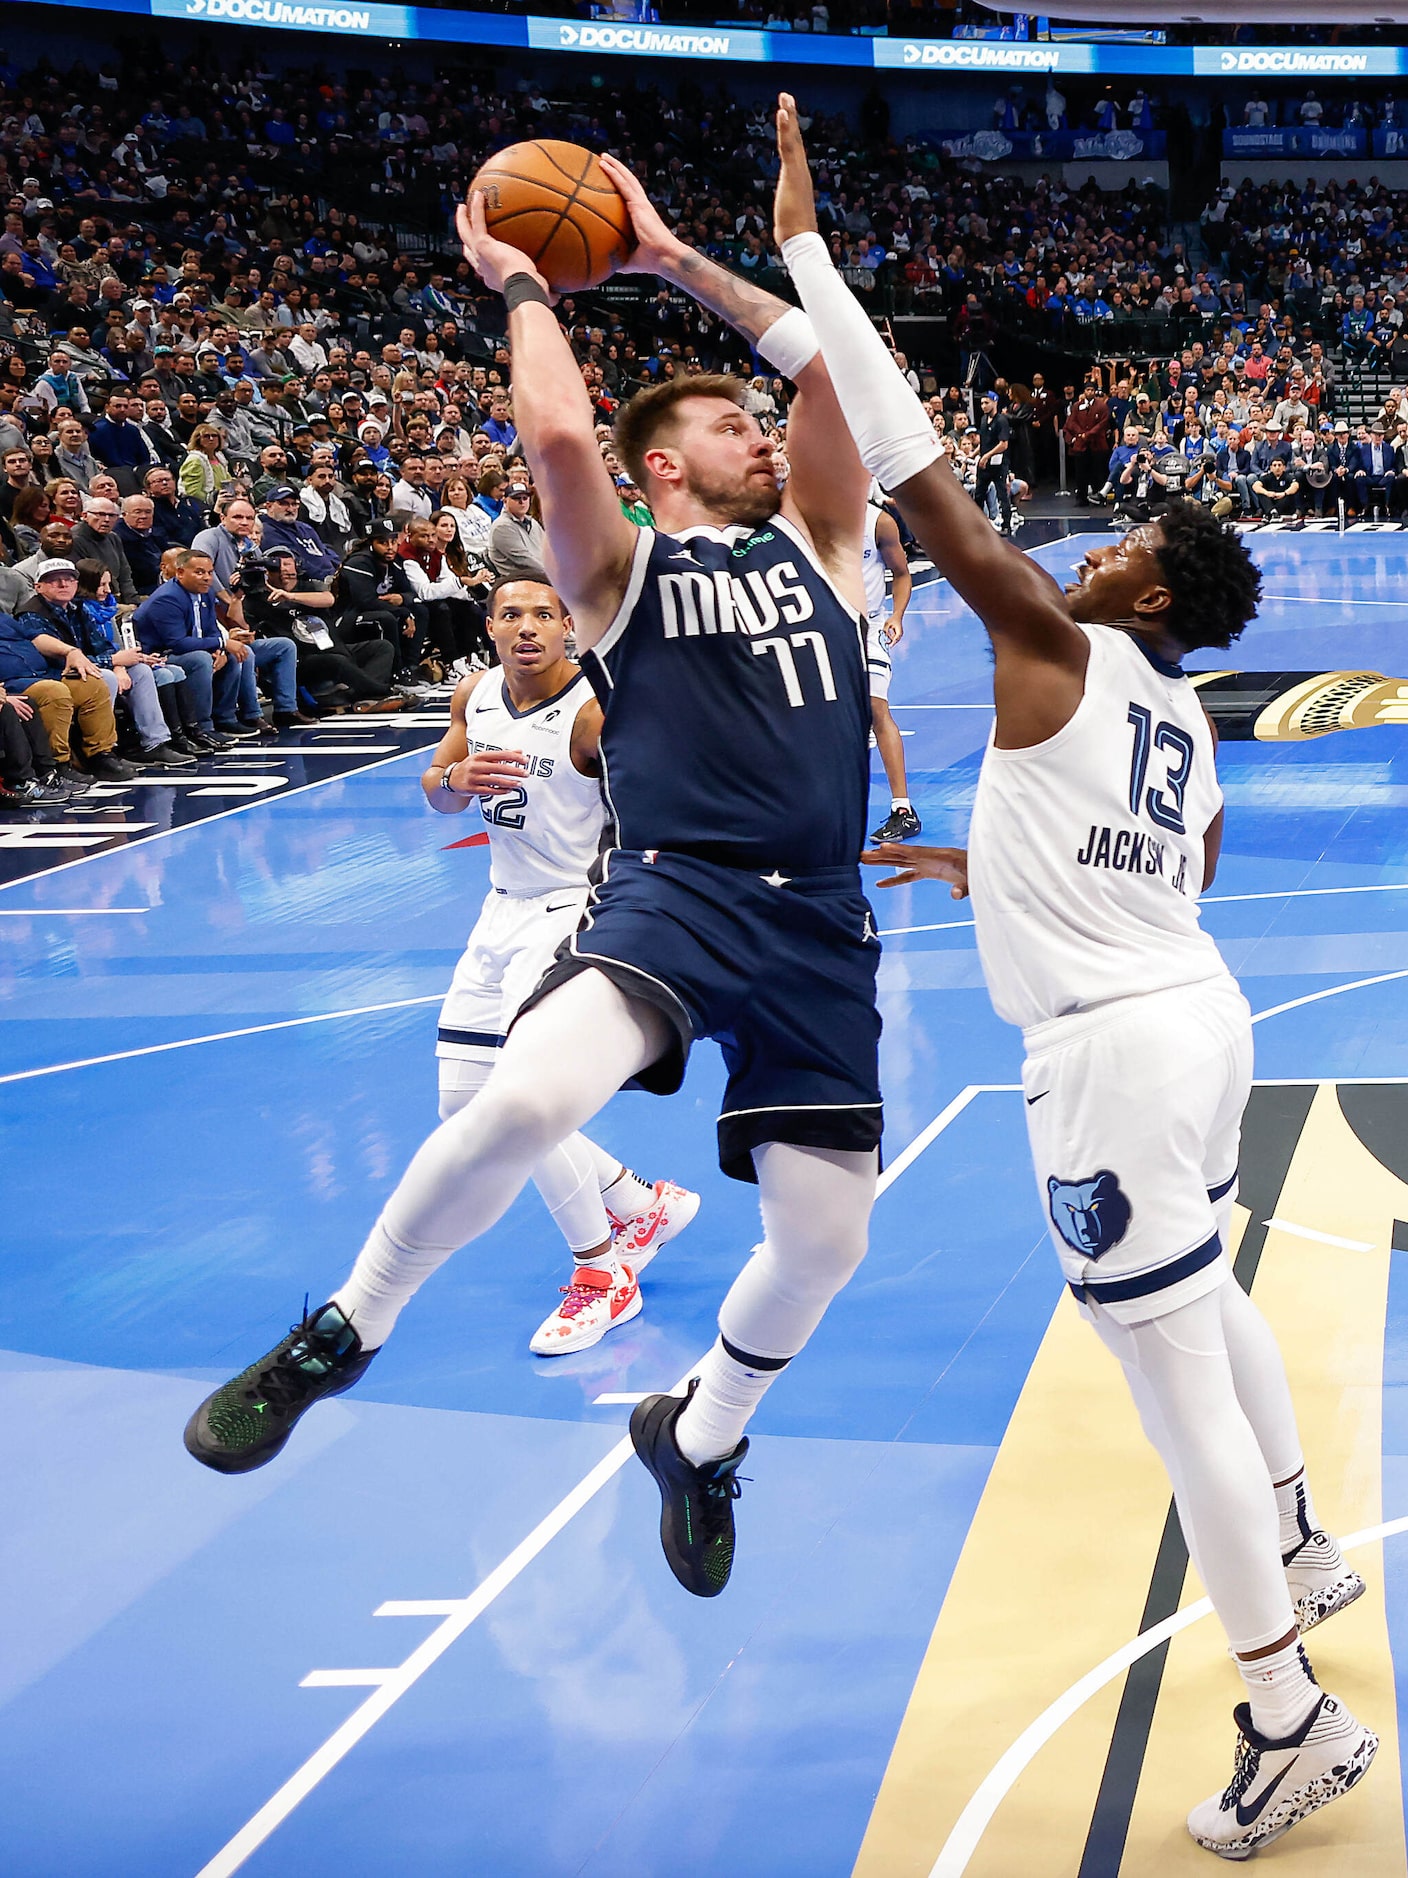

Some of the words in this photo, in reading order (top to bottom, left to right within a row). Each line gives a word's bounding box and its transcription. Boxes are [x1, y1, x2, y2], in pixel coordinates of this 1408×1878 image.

[206, 0, 370, 29] DOCUMATION
[579, 26, 730, 54] DOCUMATION
[921, 46, 1059, 68] DOCUMATION
[1238, 52, 1368, 70] DOCUMATION
[750, 630, 838, 708] 77
[1127, 700, 1194, 836] 13
